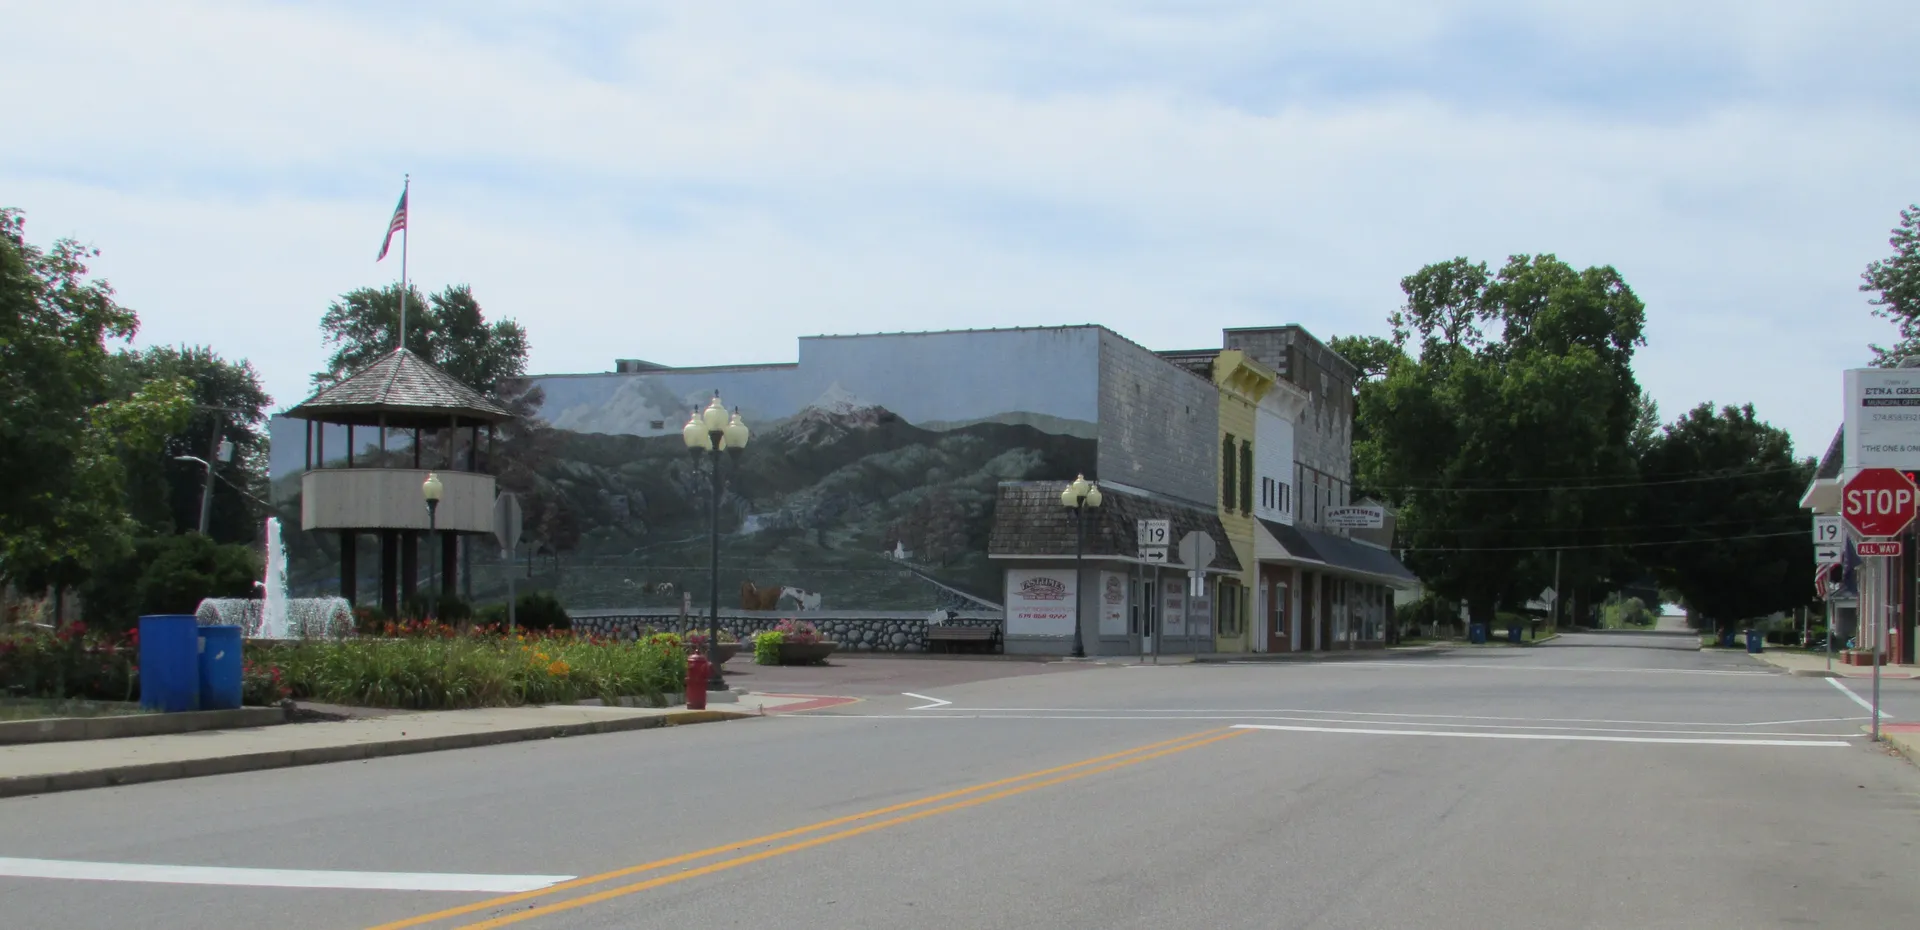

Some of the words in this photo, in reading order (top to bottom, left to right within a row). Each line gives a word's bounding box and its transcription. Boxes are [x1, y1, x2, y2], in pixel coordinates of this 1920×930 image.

[1865, 387, 1892, 395] ETNA
[1882, 444, 1898, 452] ONE
[1846, 489, 1911, 515] STOP
[1149, 528, 1164, 542] 19
[1818, 525, 1837, 540] 19
[1860, 545, 1875, 554] ALL
[1879, 545, 1896, 554] WAY
